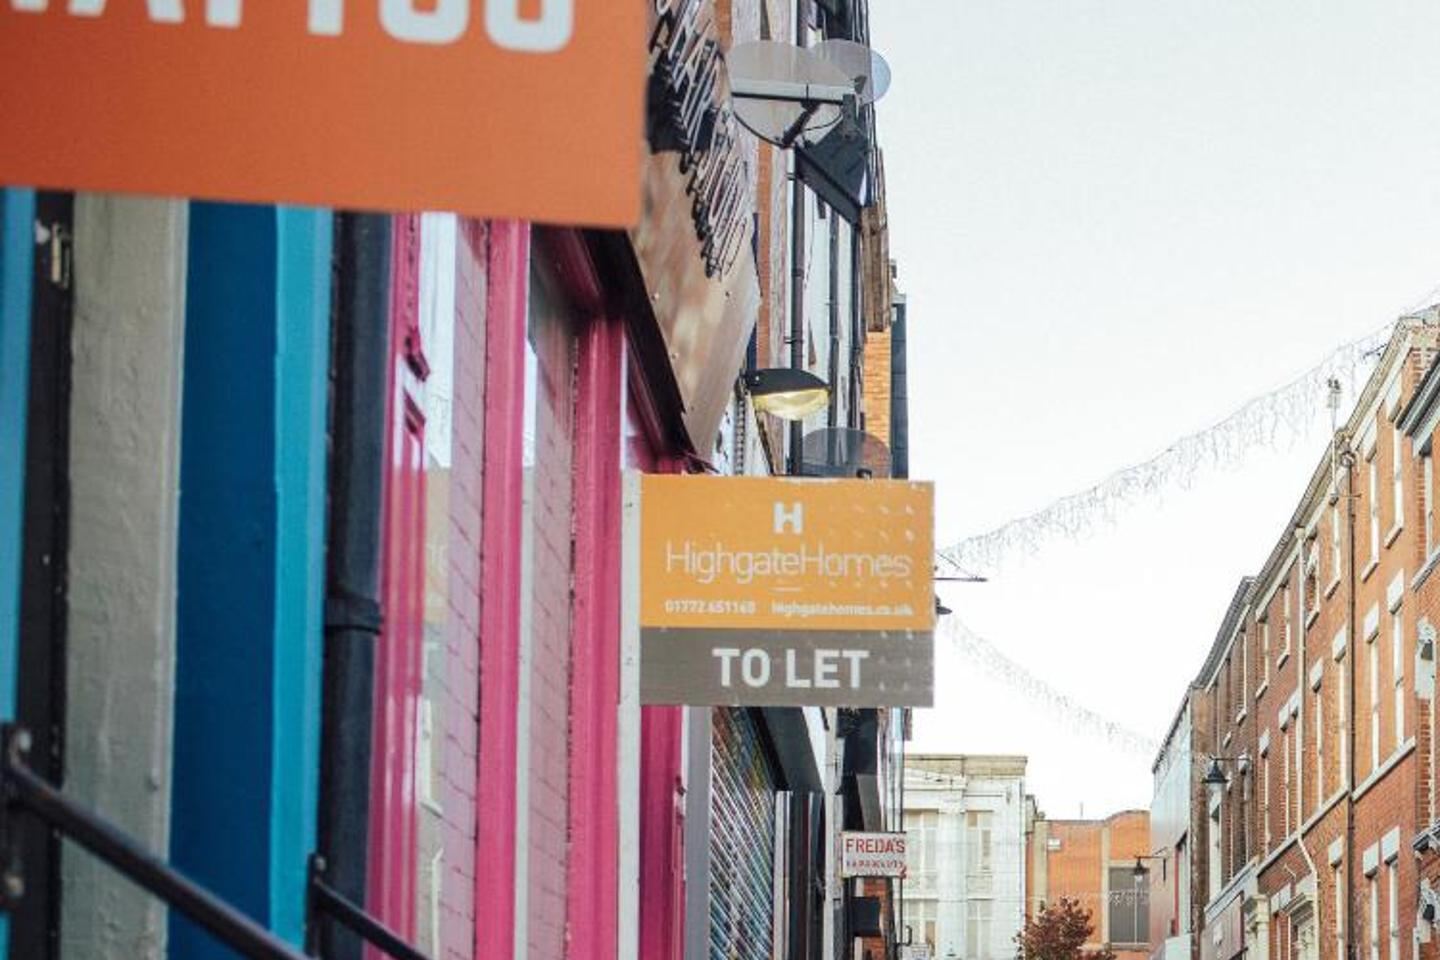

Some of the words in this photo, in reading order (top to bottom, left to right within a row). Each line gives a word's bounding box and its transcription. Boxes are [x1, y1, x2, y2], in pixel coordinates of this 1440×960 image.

[664, 541, 913, 585] HighgateHomes
[712, 648, 771, 688] TO
[785, 649, 870, 689] LET
